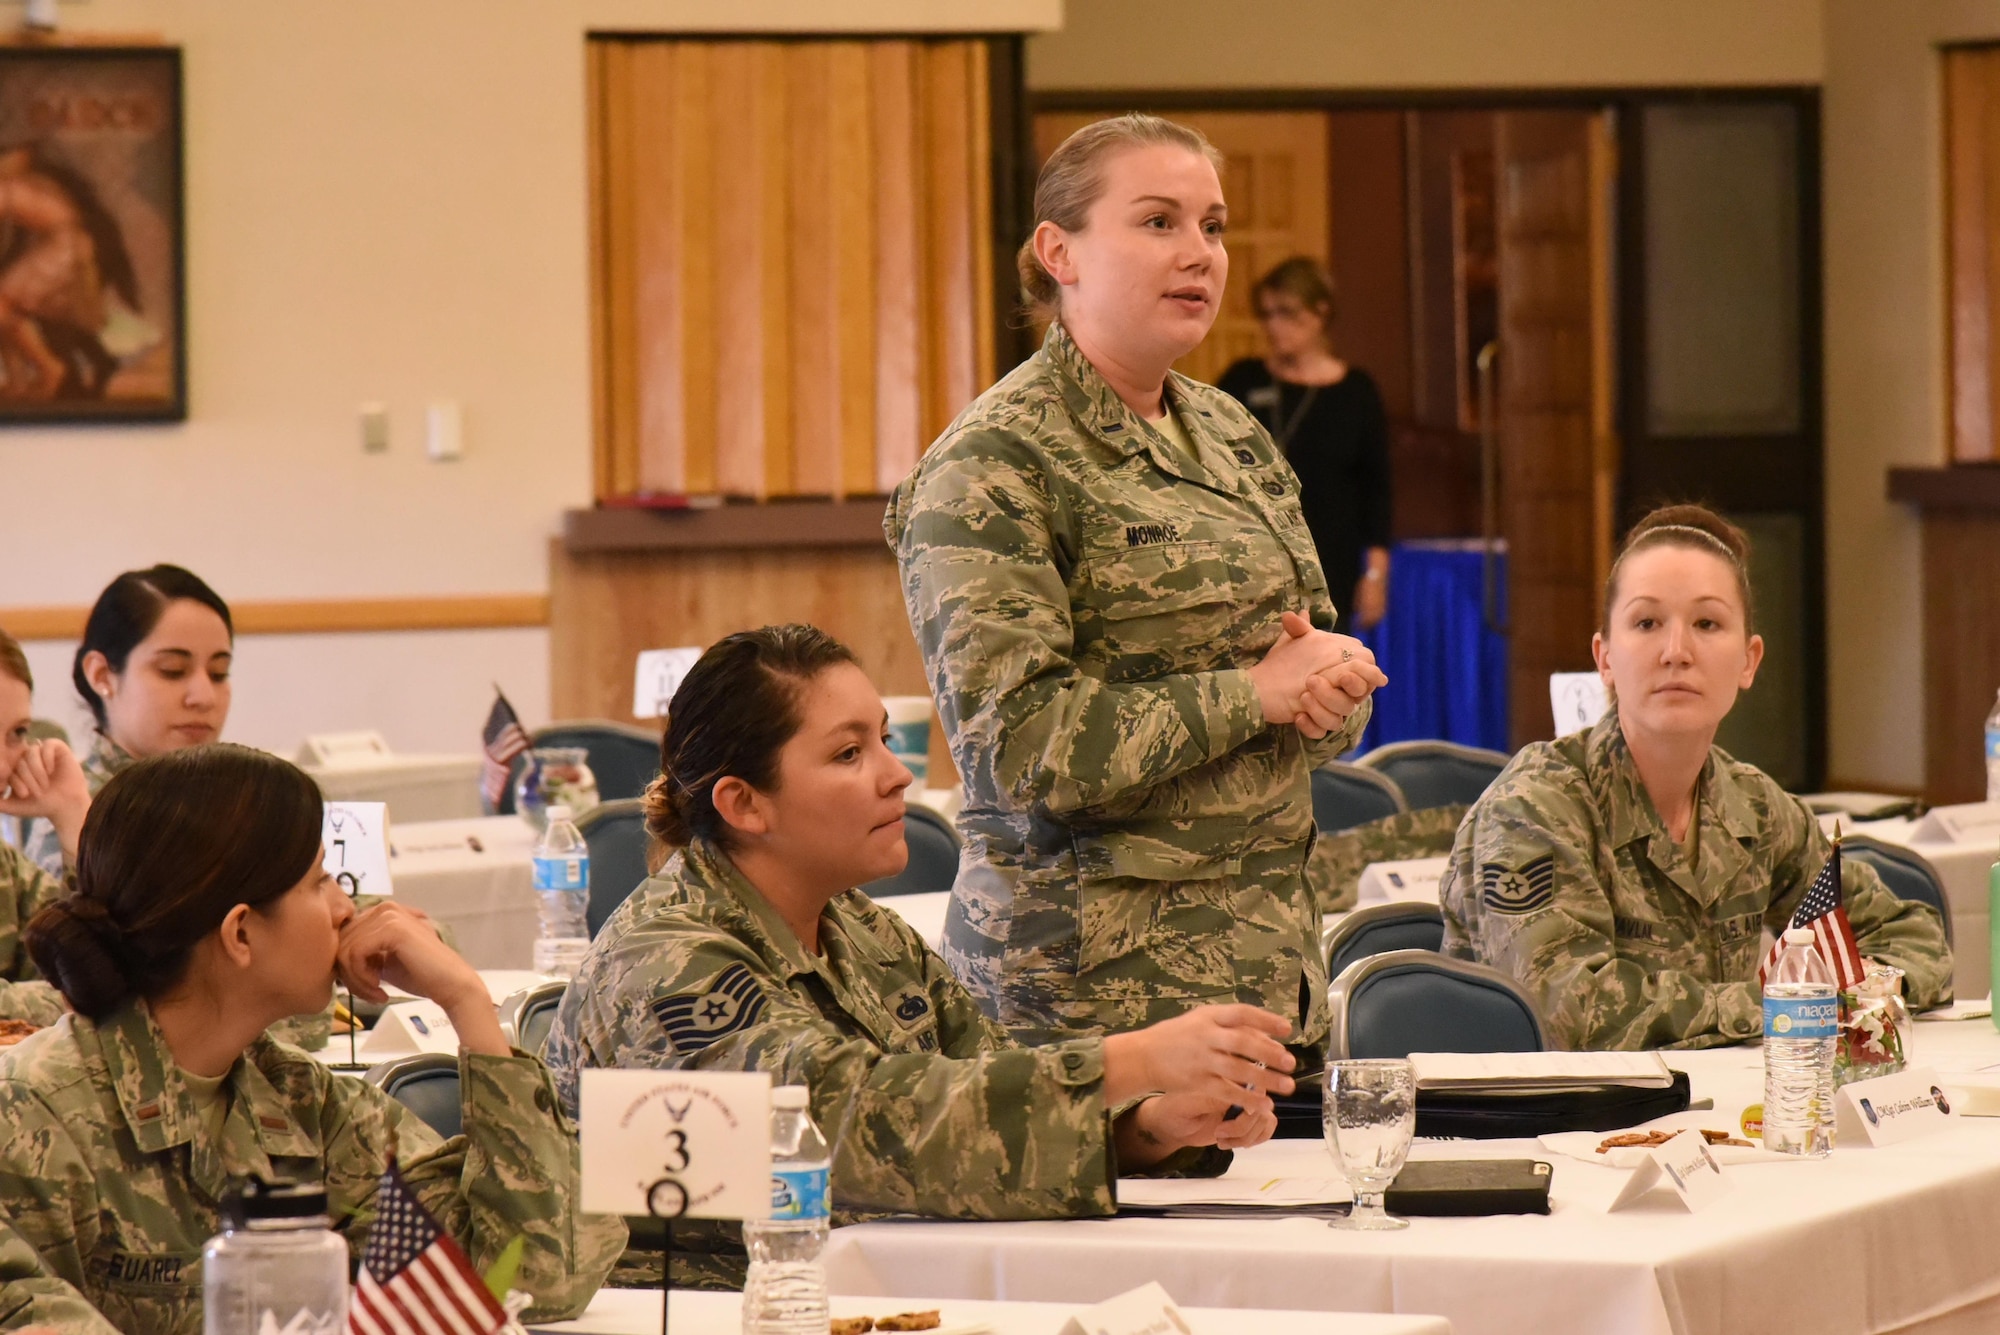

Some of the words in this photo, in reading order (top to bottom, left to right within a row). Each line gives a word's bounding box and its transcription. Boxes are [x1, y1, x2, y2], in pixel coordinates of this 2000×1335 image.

[1126, 524, 1182, 547] MONROE
[1577, 699, 1588, 723] 6
[333, 839, 346, 868] 7
[1744, 913, 1763, 936] AIR
[916, 1030, 938, 1053] AIR
[664, 1129, 691, 1174] 3
[108, 1252, 182, 1283] SUAREZ
